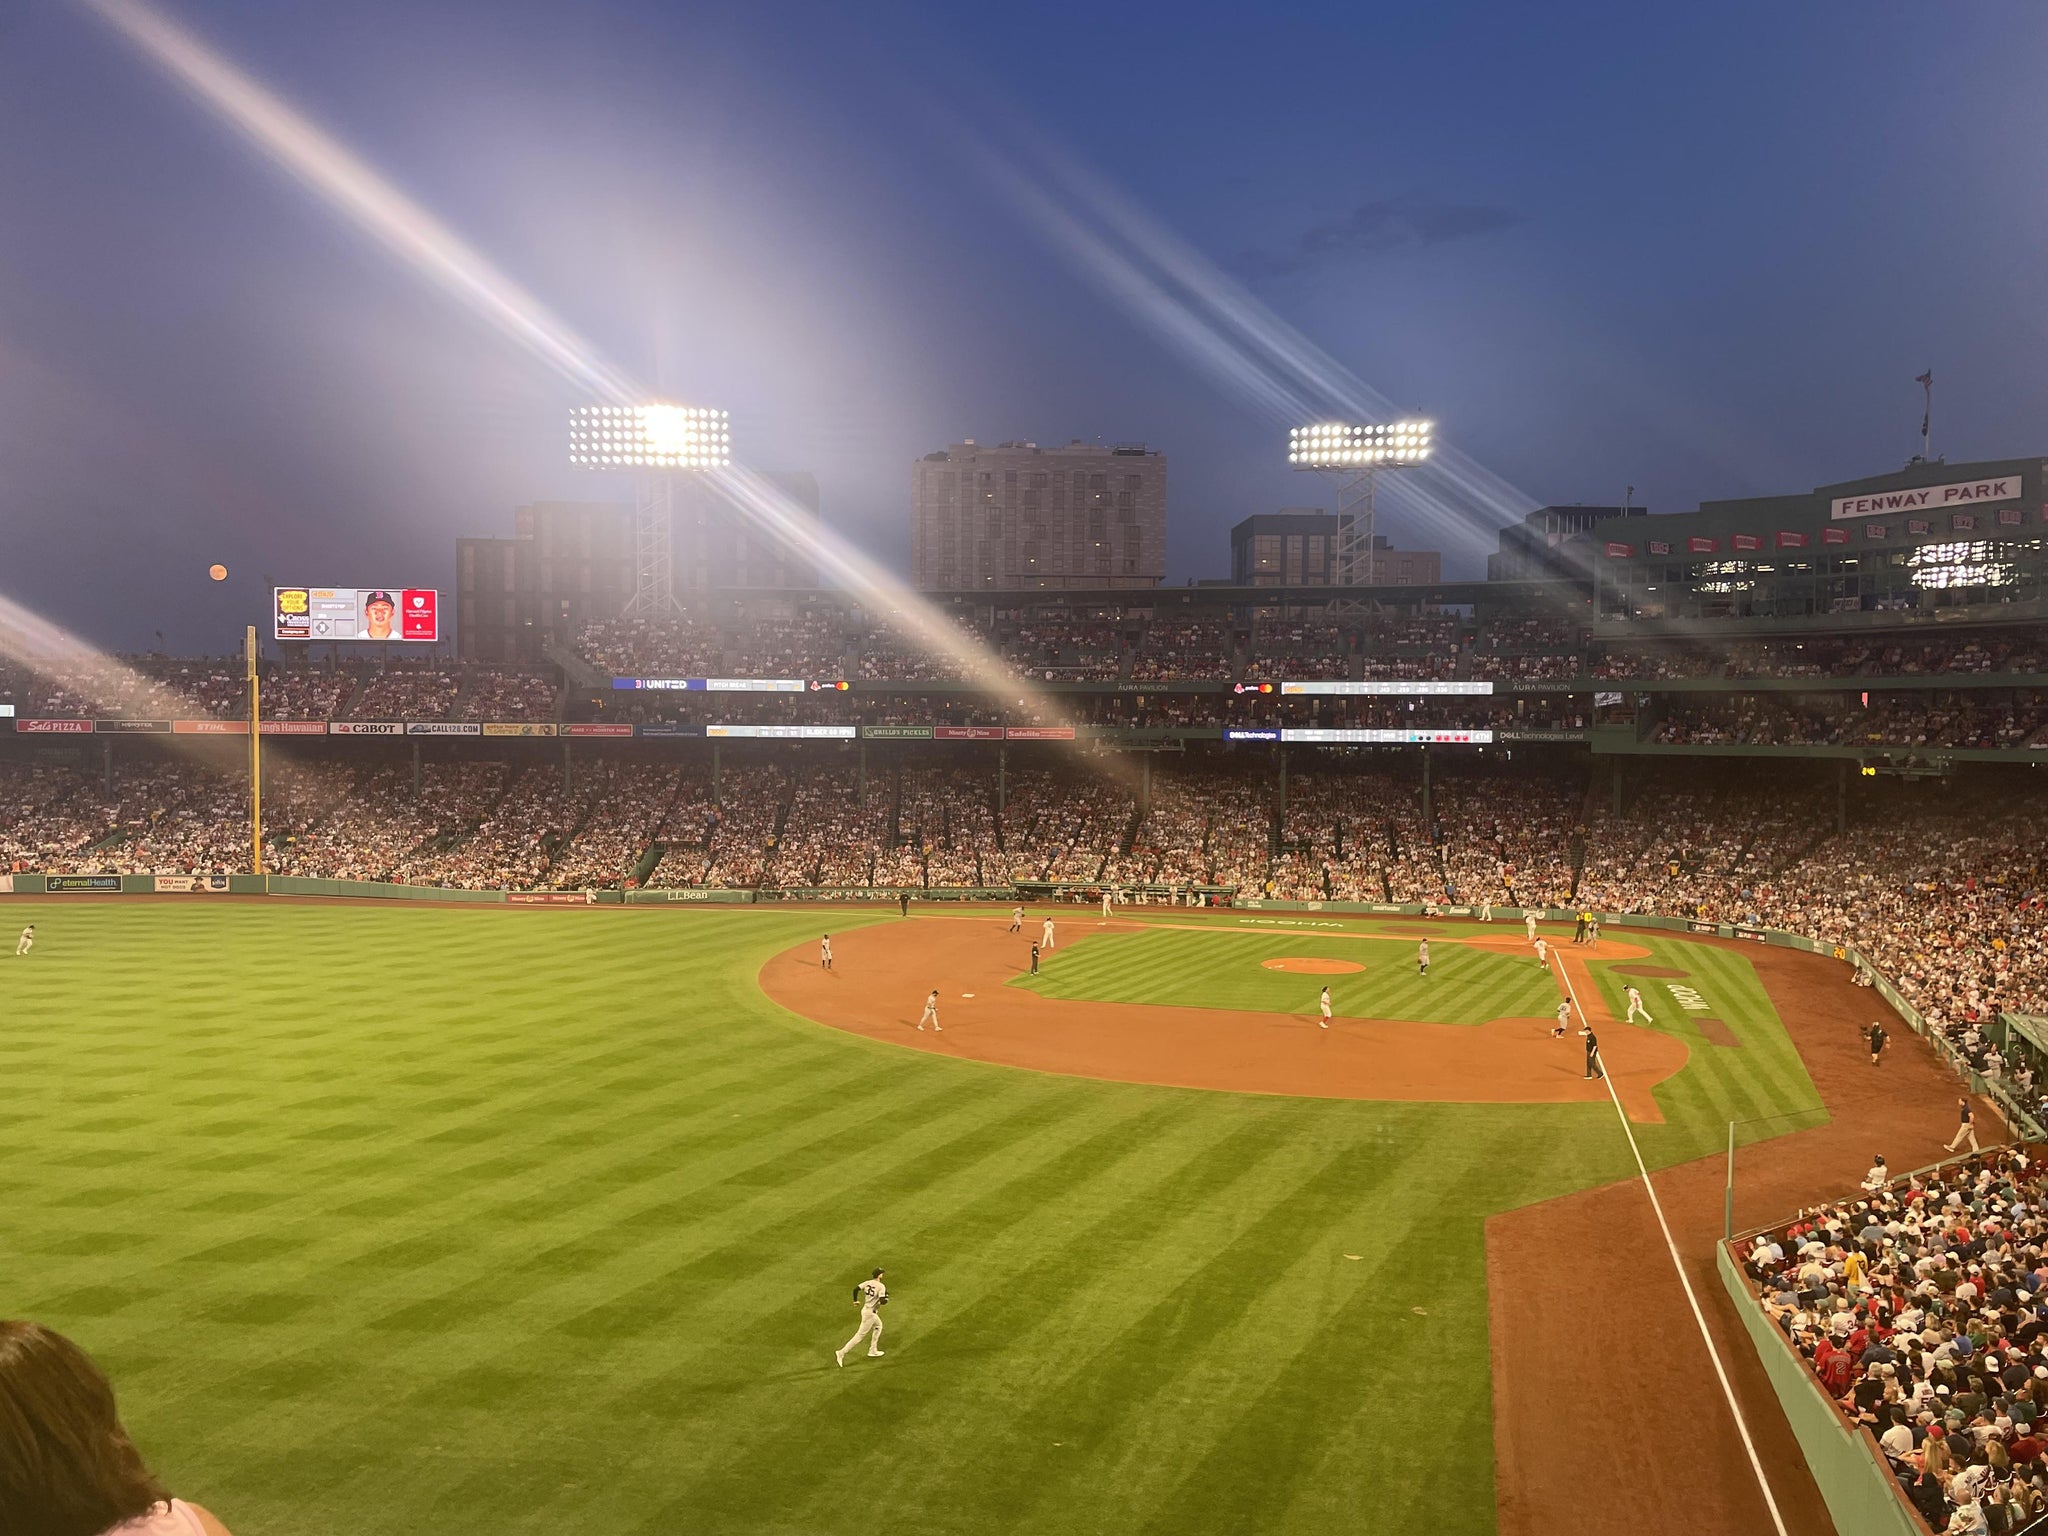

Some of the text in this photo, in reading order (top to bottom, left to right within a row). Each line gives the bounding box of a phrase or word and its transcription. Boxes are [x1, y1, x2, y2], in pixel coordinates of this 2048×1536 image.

[1842, 480, 2008, 514] FENWAY PARK
[646, 680, 687, 689] UNITED
[27, 720, 82, 731] Sal's PIZZA
[197, 723, 226, 731] STIHL
[282, 723, 324, 732] Hawaiian
[431, 725, 479, 733] CALL128.COM
[1245, 732, 1276, 740] Technologies
[1520, 732, 1564, 740] Technologies
[1566, 732, 1584, 740] Level
[62, 878, 117, 887] eternalHealth
[668, 890, 708, 900] L.L.Bean
[865, 1284, 876, 1297] 35
[1835, 1361, 1846, 1375] 2
